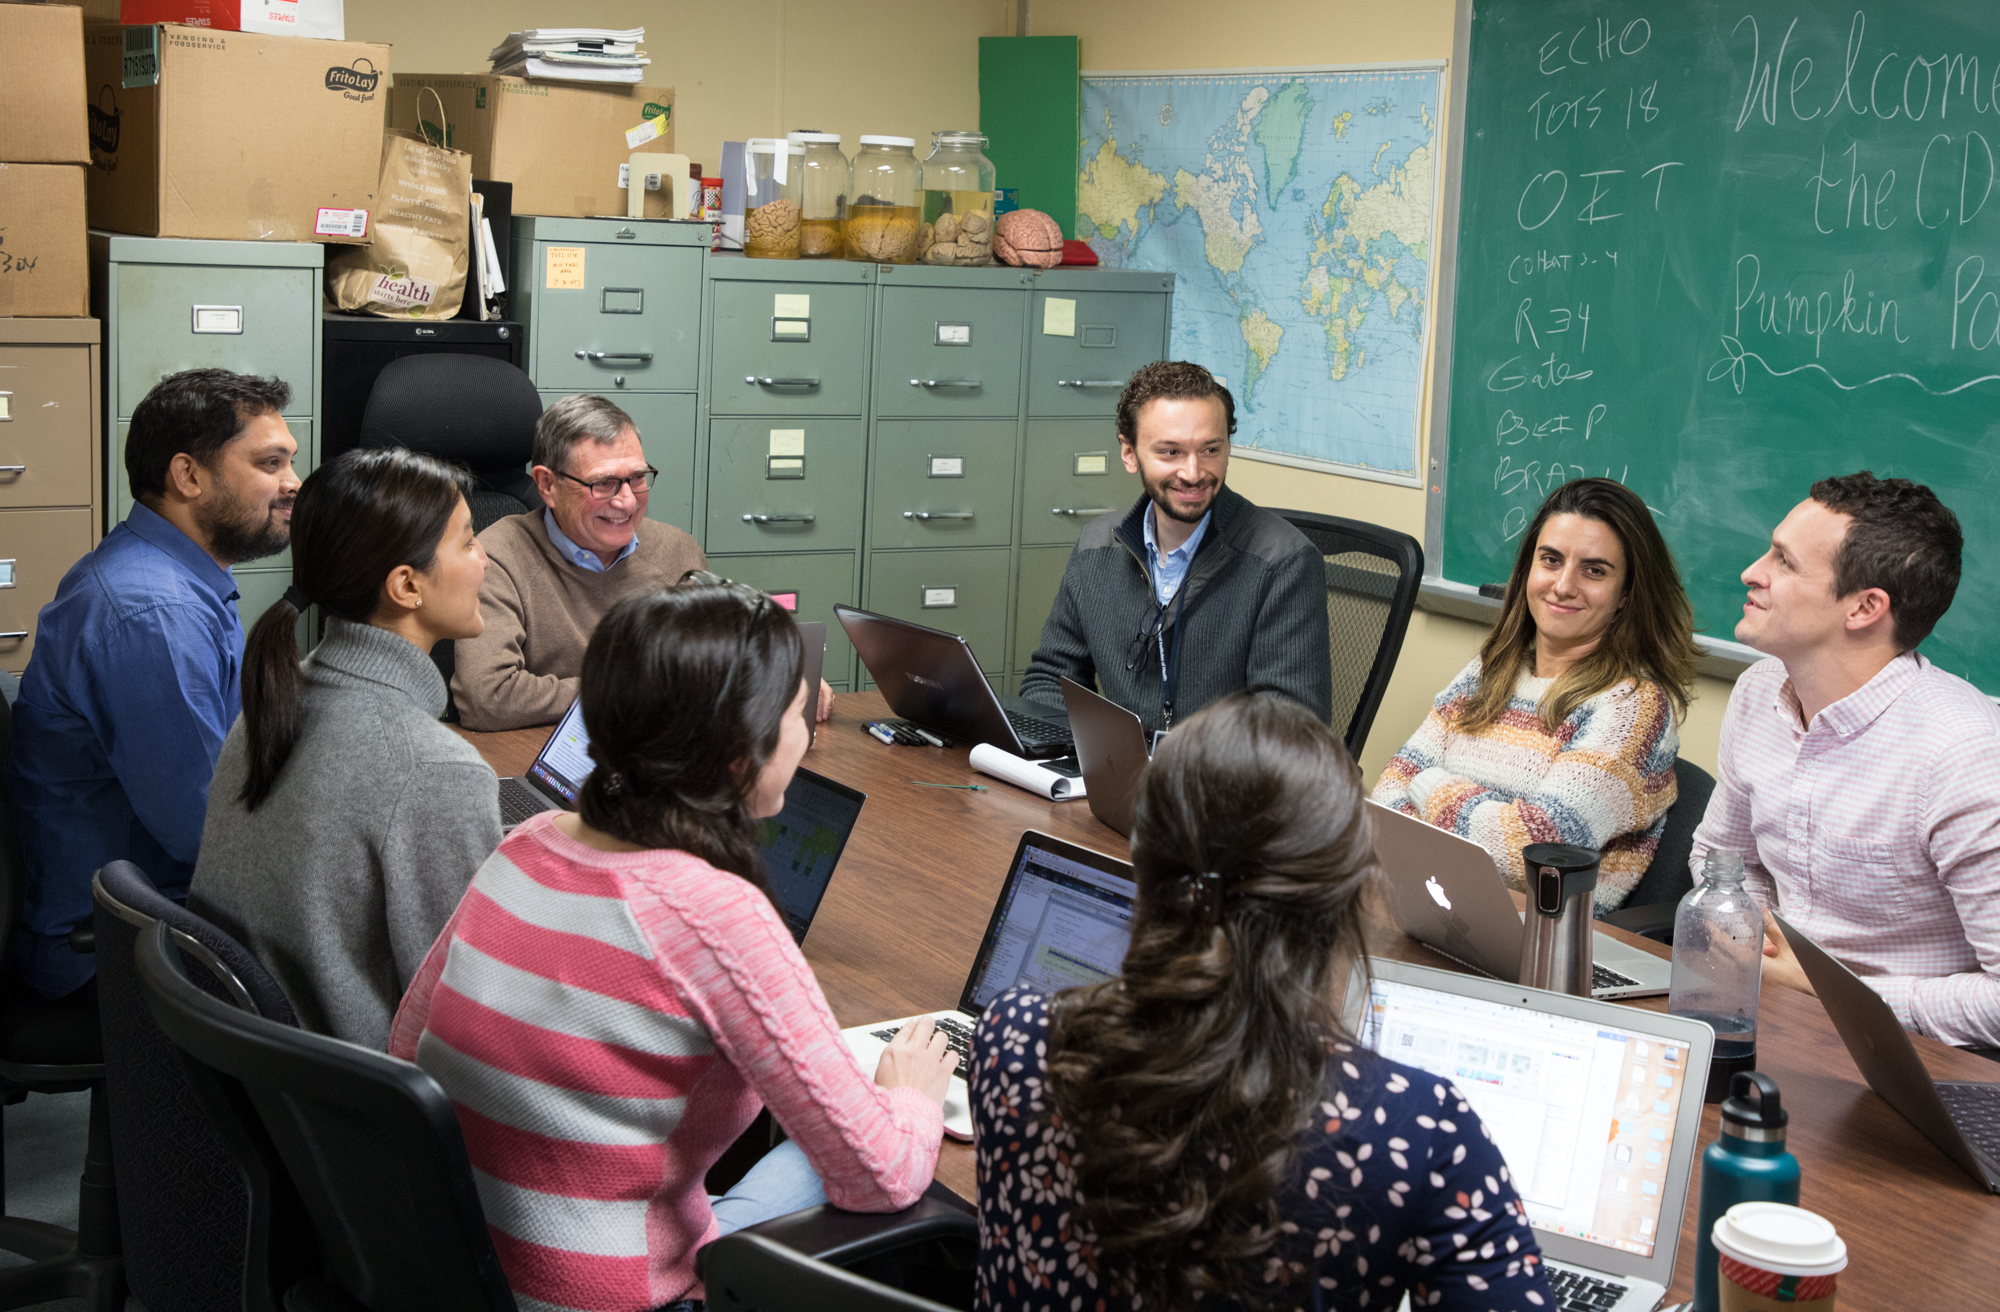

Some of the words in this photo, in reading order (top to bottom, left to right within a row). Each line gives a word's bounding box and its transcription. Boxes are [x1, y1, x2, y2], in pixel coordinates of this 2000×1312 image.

[186, 18, 210, 26] STAPLES
[269, 12, 295, 23] STAPLES
[170, 34, 214, 44] VENDING
[170, 41, 226, 50] FOODSERVICE
[1539, 18, 1651, 75] ECHO
[1731, 10, 2000, 132] Welcom
[502, 82, 540, 91] VENDING
[502, 88, 549, 97] FOODSERVICE
[1528, 87, 1606, 140] TOTS
[1626, 80, 1659, 130] 18
[423, 158, 452, 173] healthy
[442, 155, 456, 164] you
[410, 165, 440, 178] choices:
[398, 179, 424, 190] WHOLE
[425, 186, 447, 196] FOOD
[1806, 142, 1897, 234] the
[391, 194, 415, 204] PLANT
[389, 209, 423, 221] HEALTHY
[424, 216, 442, 225] FATS
[377, 276, 430, 302] health
[374, 290, 394, 300] starts
[396, 296, 412, 306] here
[1736, 254, 1910, 358] Pumpkin
[905, 672, 944, 690] TOSHIBA
